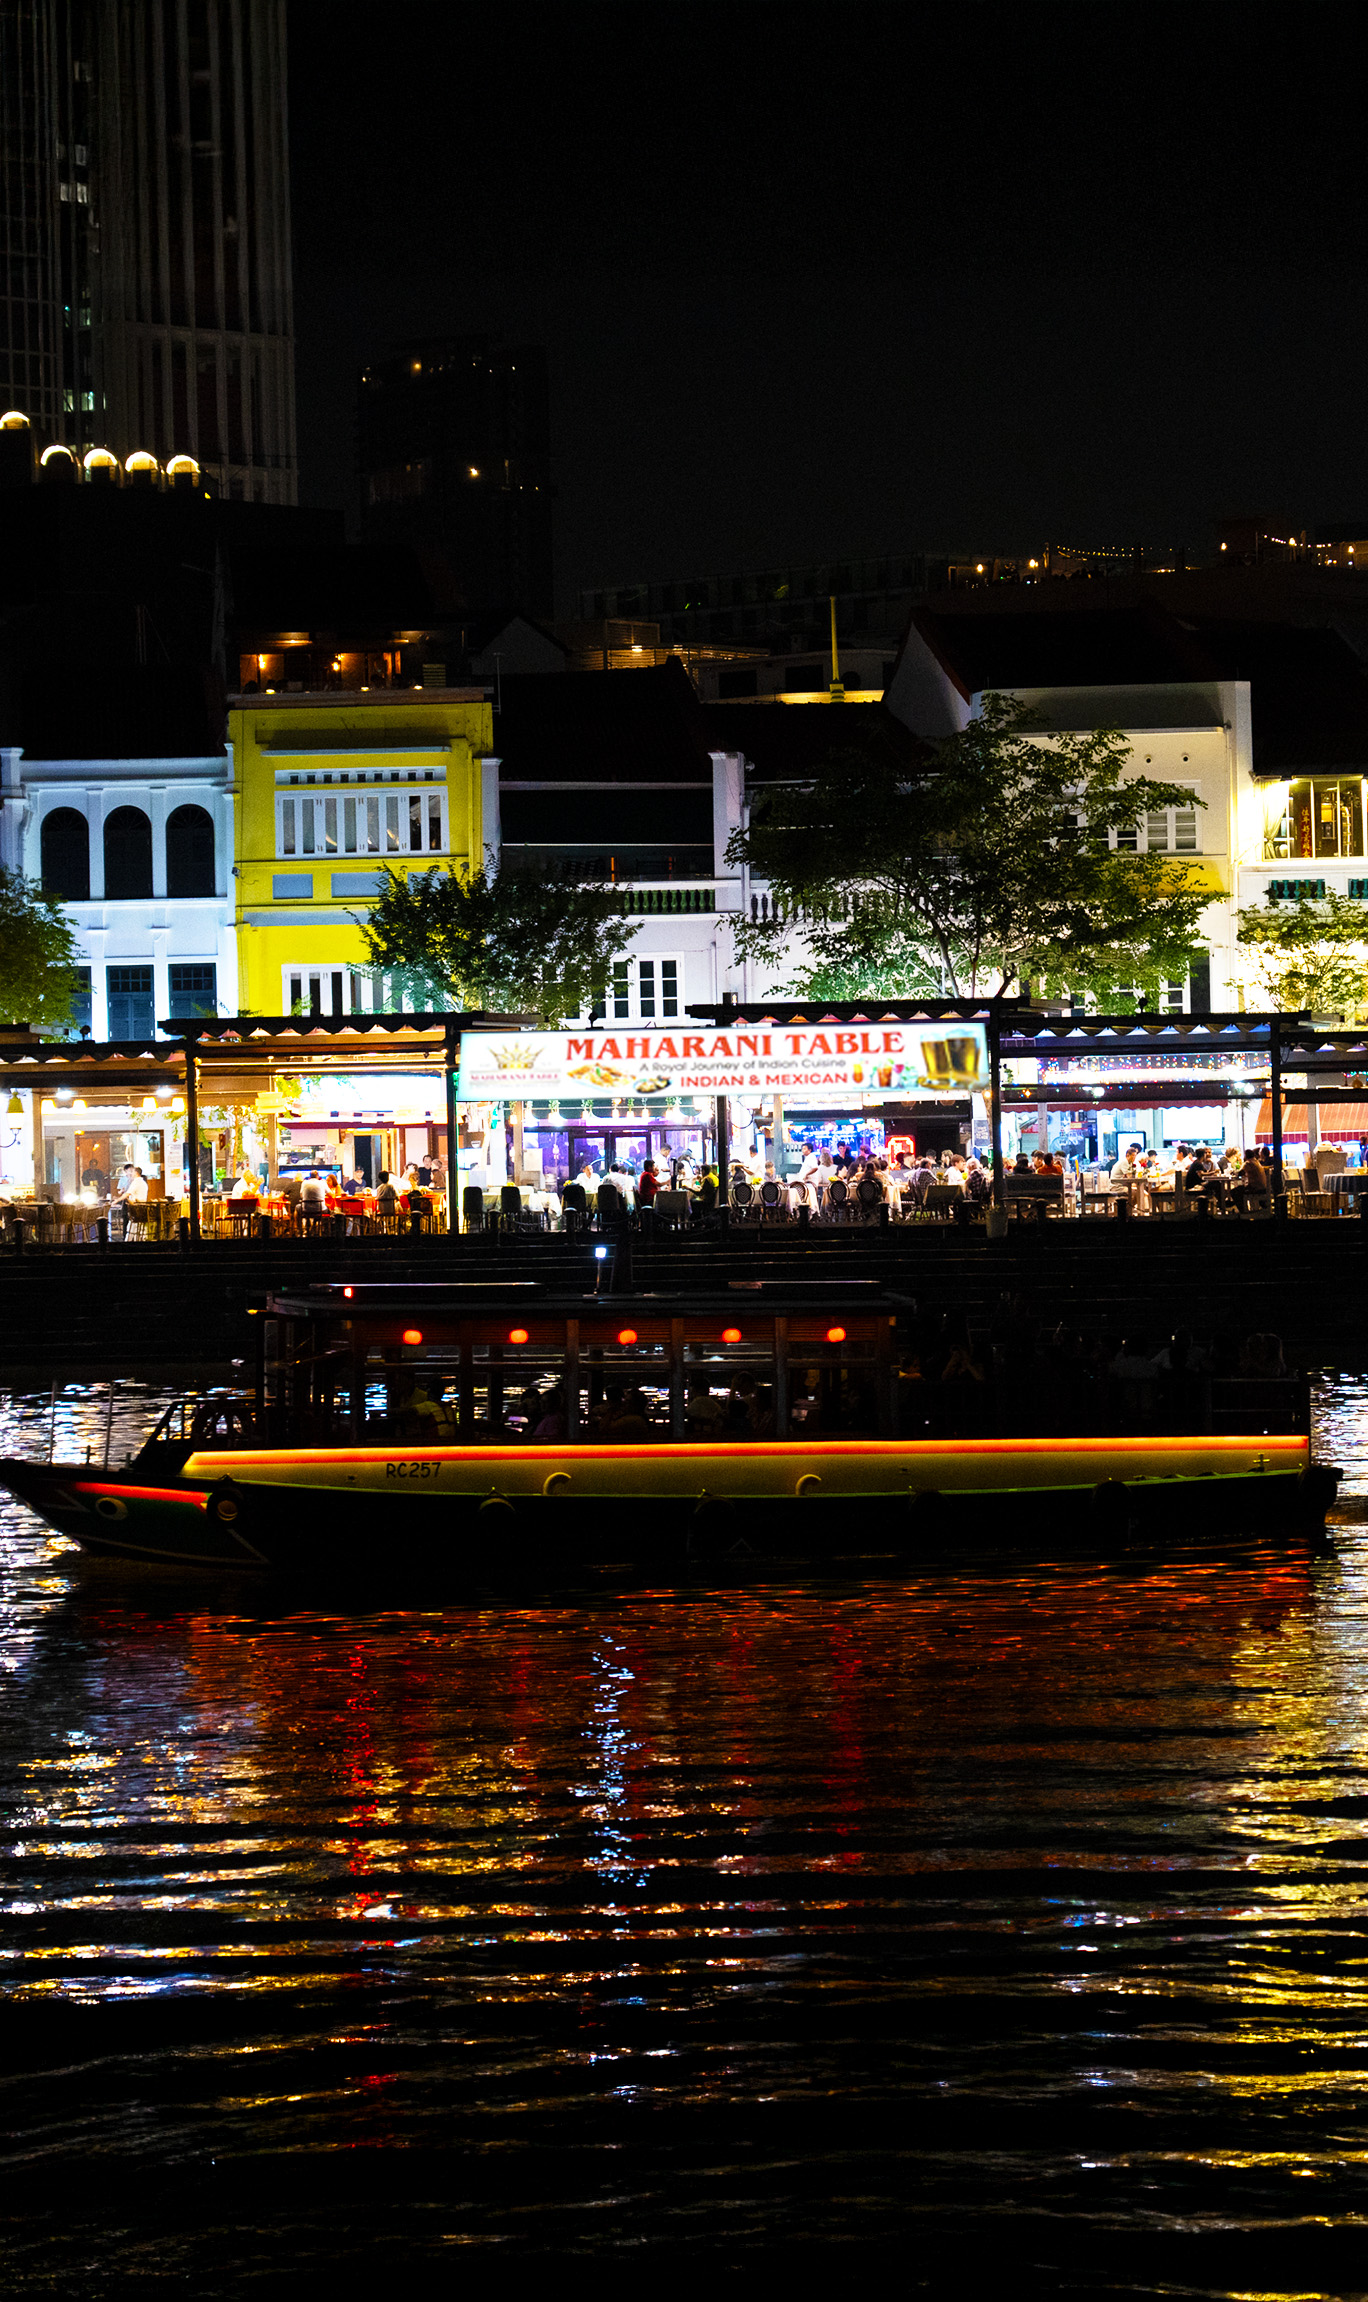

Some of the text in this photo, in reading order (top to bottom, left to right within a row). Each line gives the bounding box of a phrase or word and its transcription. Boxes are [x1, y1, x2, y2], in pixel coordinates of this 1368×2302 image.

[566, 1031, 905, 1061] MAHARANI TABLE
[639, 1058, 846, 1073] A Royal Journey of Indian Cuisine
[680, 1072, 848, 1088] INDIAN & MEXICAN
[386, 1462, 441, 1478] RC257
